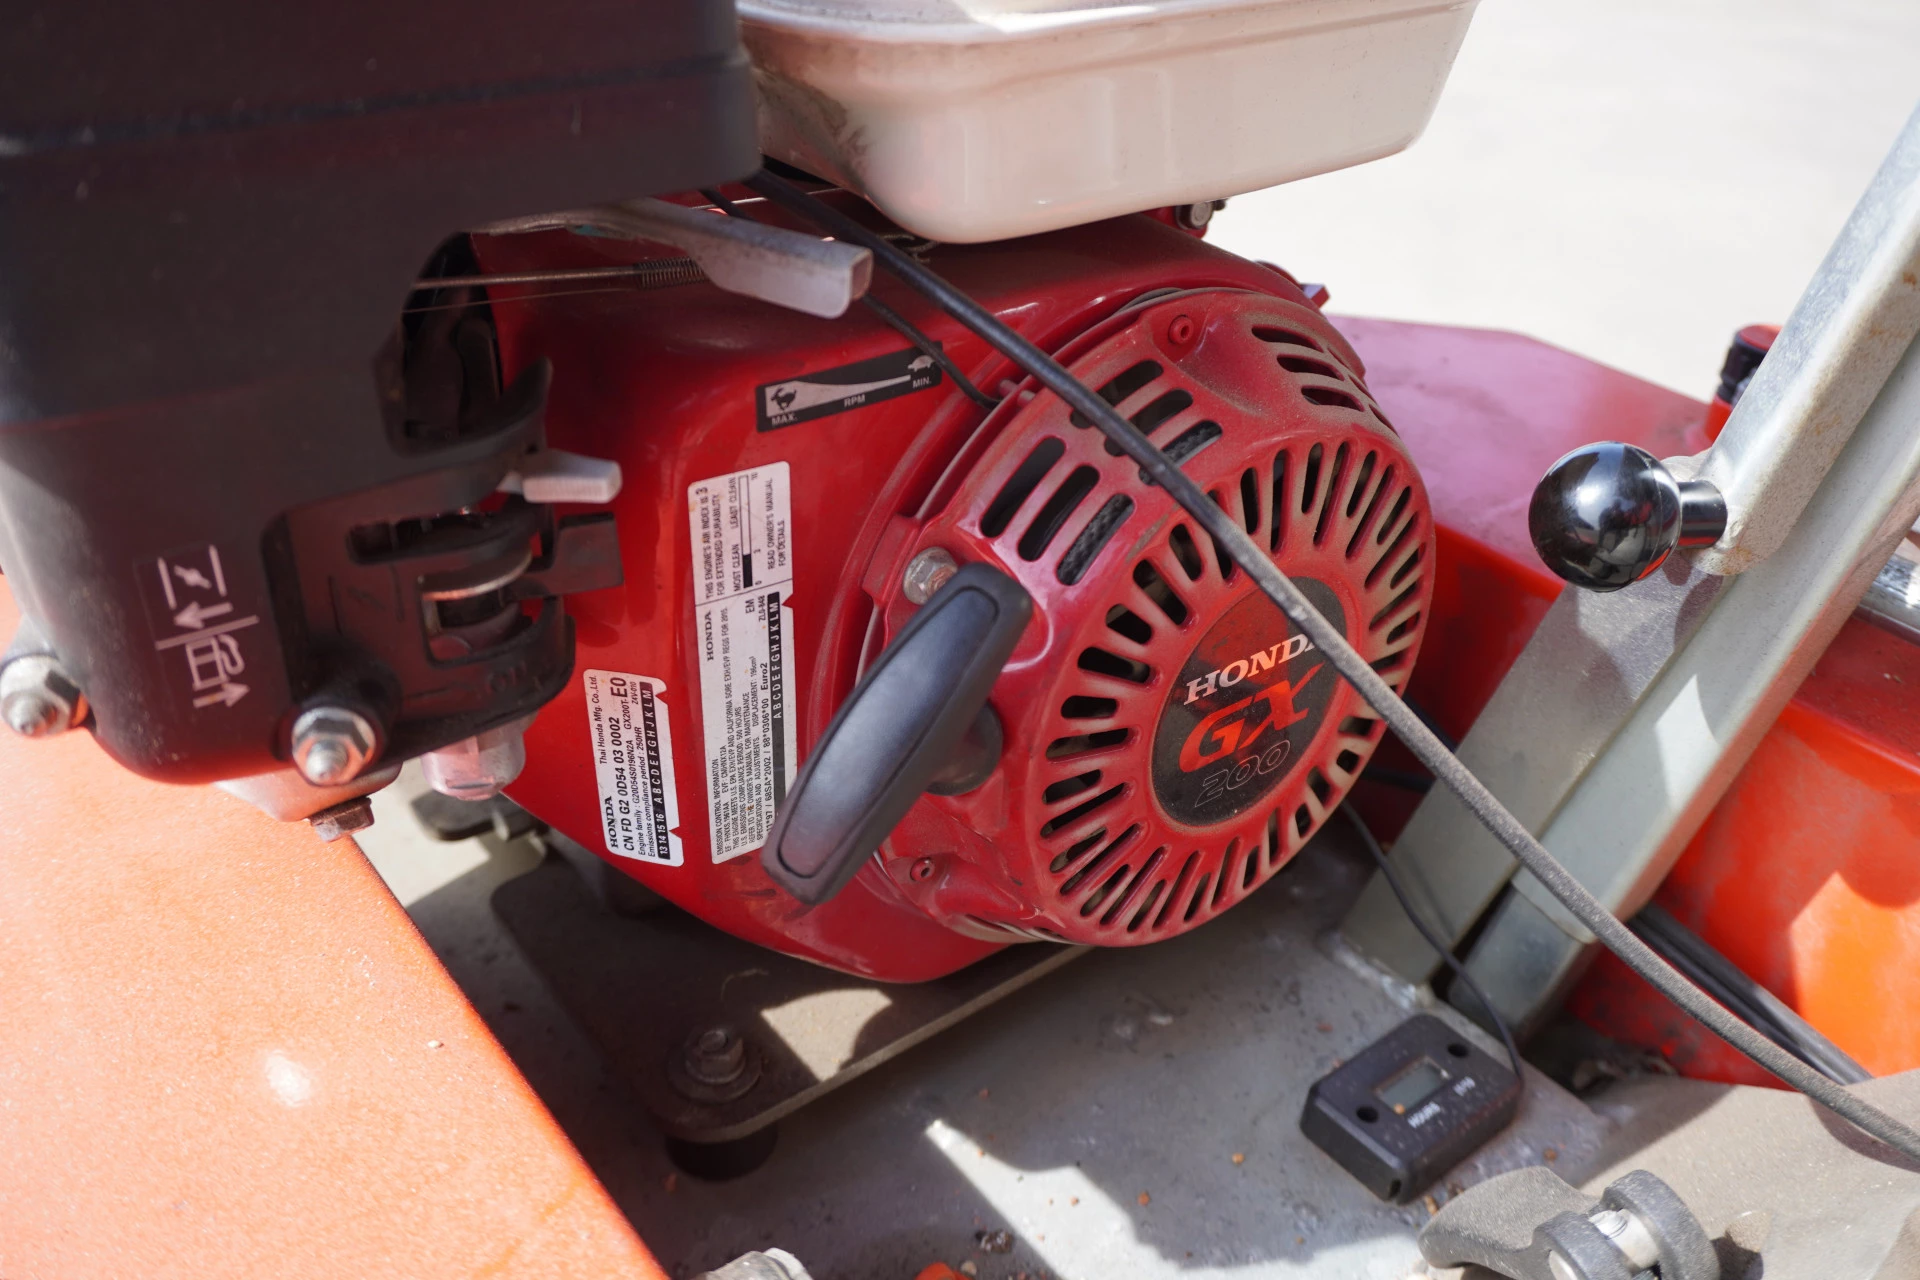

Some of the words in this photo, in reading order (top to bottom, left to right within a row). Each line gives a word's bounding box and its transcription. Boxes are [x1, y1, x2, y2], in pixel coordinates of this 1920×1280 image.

[912, 376, 932, 389] MIN.
[843, 394, 866, 408] RPM
[771, 412, 798, 426] MAX.
[696, 487, 708, 495] 3
[729, 477, 737, 503] CLEAN
[701, 507, 709, 529] INDEX
[730, 505, 738, 528] LEAST
[703, 546, 712, 580] ENGINE'S
[715, 540, 724, 579] EXTENDED
[732, 544, 740, 568] CLEAN
[767, 550, 775, 570] READ
[778, 551, 786, 567] FOR
[705, 582, 713, 599] THIS
[716, 581, 725, 596] FOR
[733, 571, 741, 592] MOST
[745, 599, 755, 614] EM
[769, 602, 778, 613] M
[705, 611, 714, 661] HONDA
[770, 623, 779, 632] K
[771, 644, 779, 652] H
[771, 653, 780, 662] G
[760, 662, 768, 691] Euro2
[1184, 633, 1316, 706] HOND
[610, 677, 628, 698] E0
[642, 690, 651, 699] M
[772, 683, 781, 691] D
[773, 693, 781, 701] C
[593, 706, 602, 722] Mfg.
[743, 692, 751, 737] MAINTENANCE
[773, 702, 781, 710] B
[726, 700, 734, 734] CALIFORNIA
[734, 706, 742, 729] HOURS
[1179, 662, 1325, 773] GX
[596, 723, 605, 747] Honda
[609, 717, 622, 746] 0002
[634, 726, 644, 751] 250HR
[599, 749, 607, 764] Thai
[613, 749, 624, 764] 03
[638, 756, 648, 780] period
[651, 768, 659, 776] D
[1195, 740, 1290, 808] 200
[615, 767, 628, 796] 0D54
[712, 759, 720, 799] INFORMATION
[746, 777, 754, 804] OWNER'S
[619, 799, 630, 815] G2
[642, 781, 651, 821] compliance
[605, 796, 618, 848] HONDA
[634, 809, 643, 831] family
[656, 813, 664, 822] 16
[714, 800, 722, 827] CONTROL
[748, 816, 755, 826] TO
[621, 818, 632, 832] FD
[657, 824, 665, 833] 15
[623, 835, 634, 851] CN
[638, 832, 646, 856] Engine
[646, 822, 655, 857] Emissions
[658, 835, 666, 844] 14
[659, 845, 668, 855] 13
